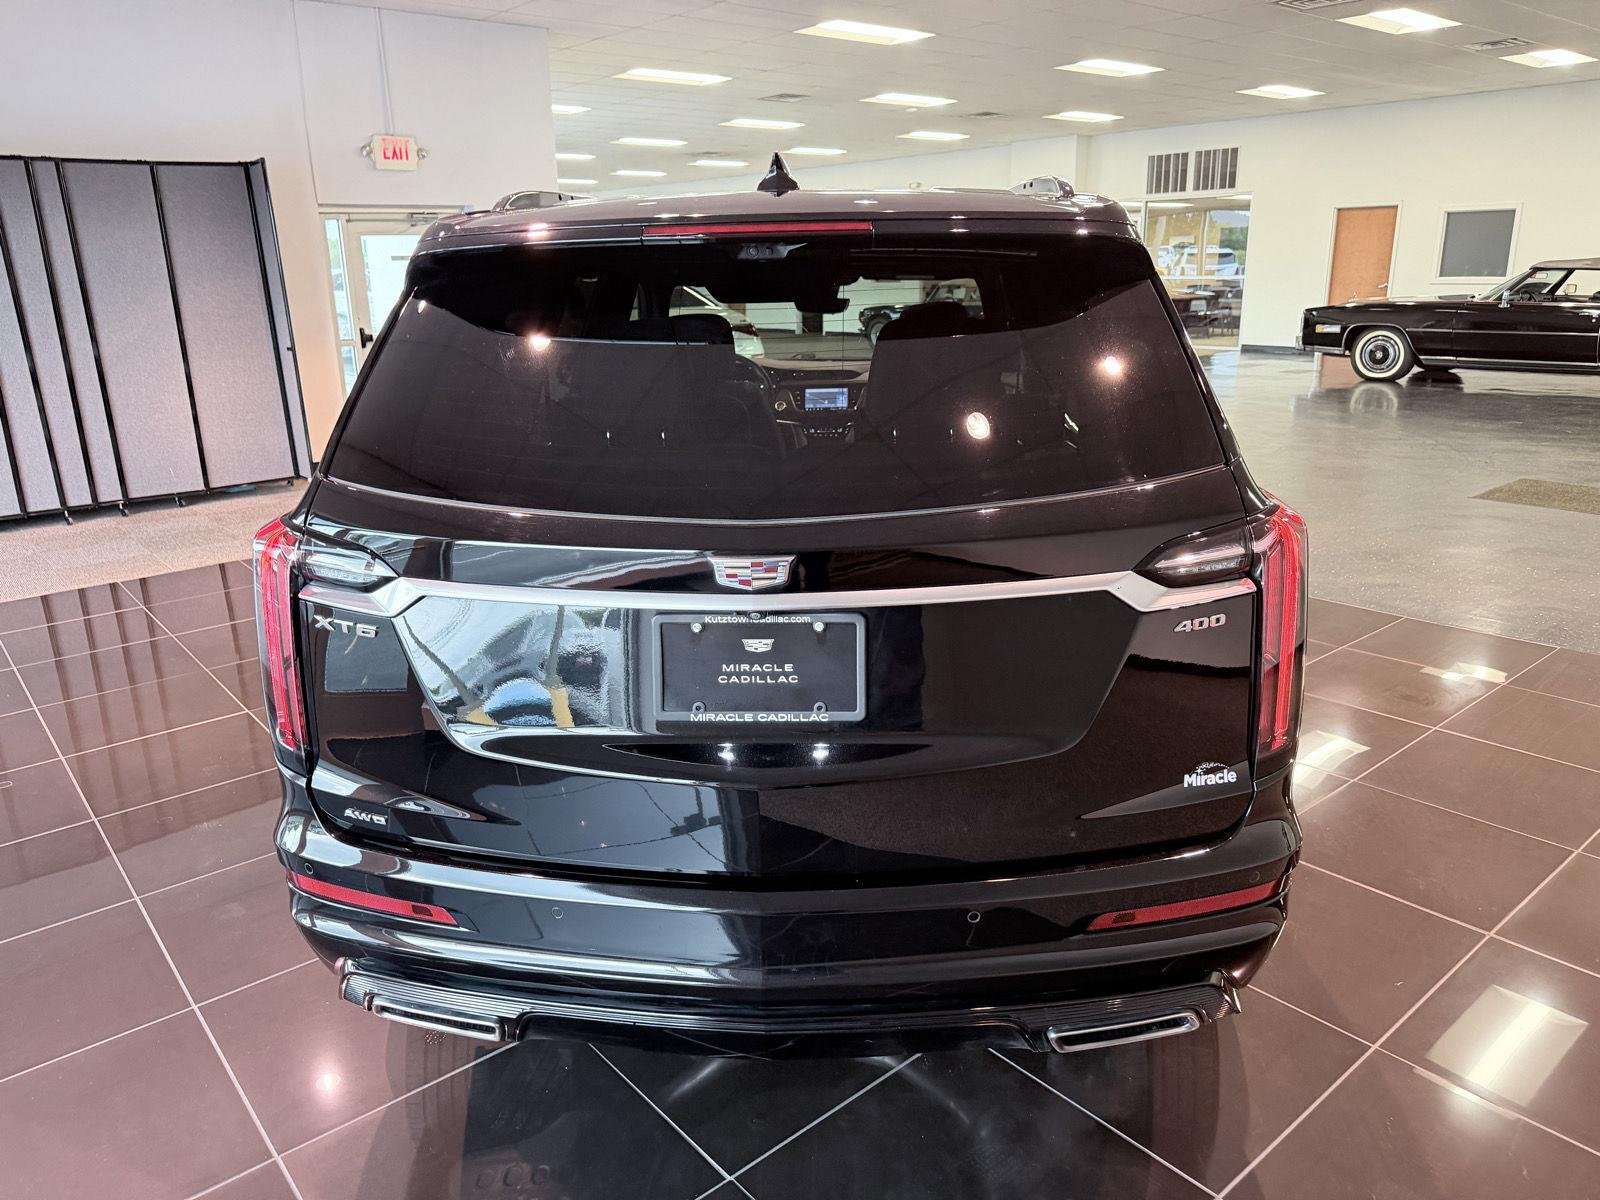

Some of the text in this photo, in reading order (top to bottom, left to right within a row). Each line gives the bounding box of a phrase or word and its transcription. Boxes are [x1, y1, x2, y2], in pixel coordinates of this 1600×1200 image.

[382, 138, 410, 161] EXIT
[313, 614, 378, 638] XT6
[1173, 613, 1226, 632] 400
[722, 663, 794, 672] MIRACLE
[718, 675, 799, 683] CADILLAC
[690, 713, 829, 721] MIRACLE CADILLAC
[1183, 768, 1237, 788] Miracle
[344, 807, 387, 826] AWD
